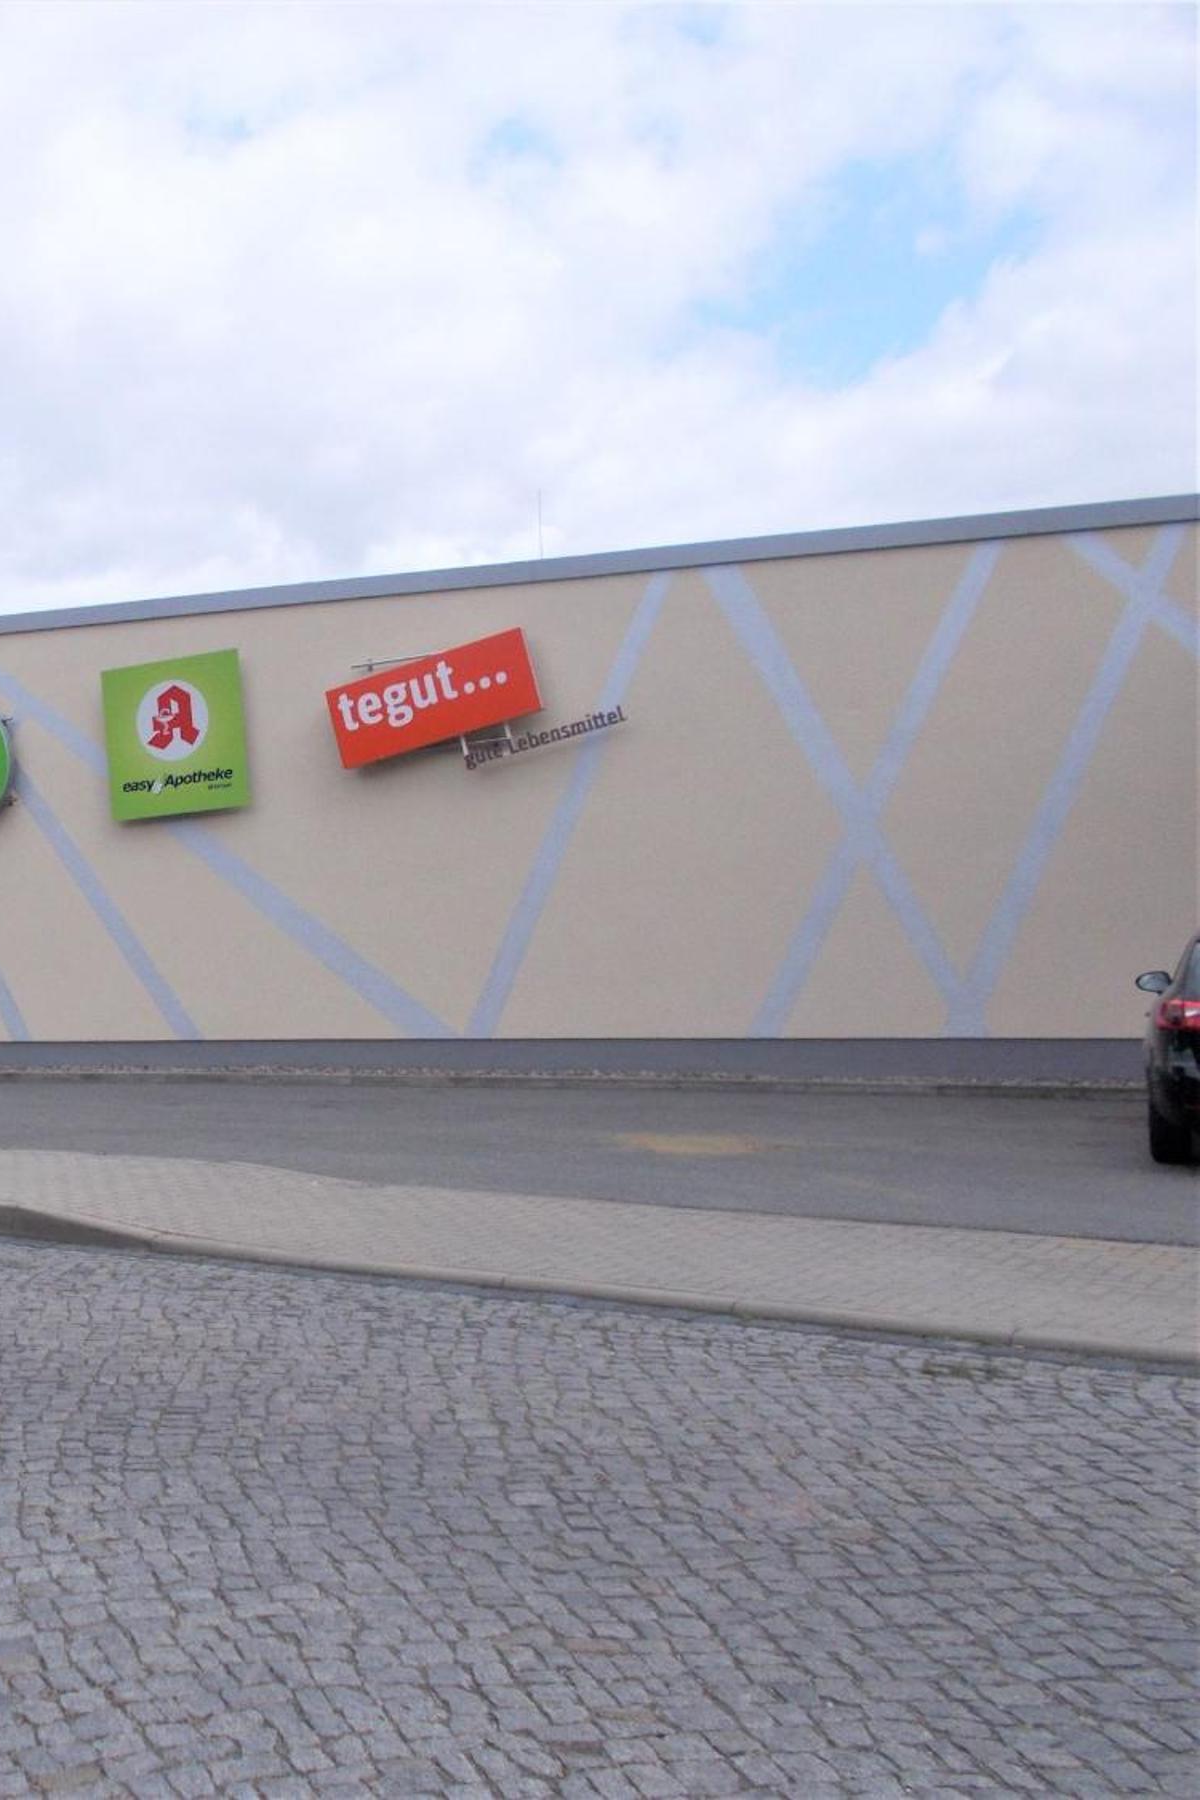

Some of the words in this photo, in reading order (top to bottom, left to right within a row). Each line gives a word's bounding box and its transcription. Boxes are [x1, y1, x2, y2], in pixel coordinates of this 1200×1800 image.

[338, 660, 508, 731] tegut...
[464, 739, 504, 770] gute
[508, 705, 627, 754] Lebensmittel
[122, 779, 155, 793] easy
[164, 767, 233, 788] Apotheke
